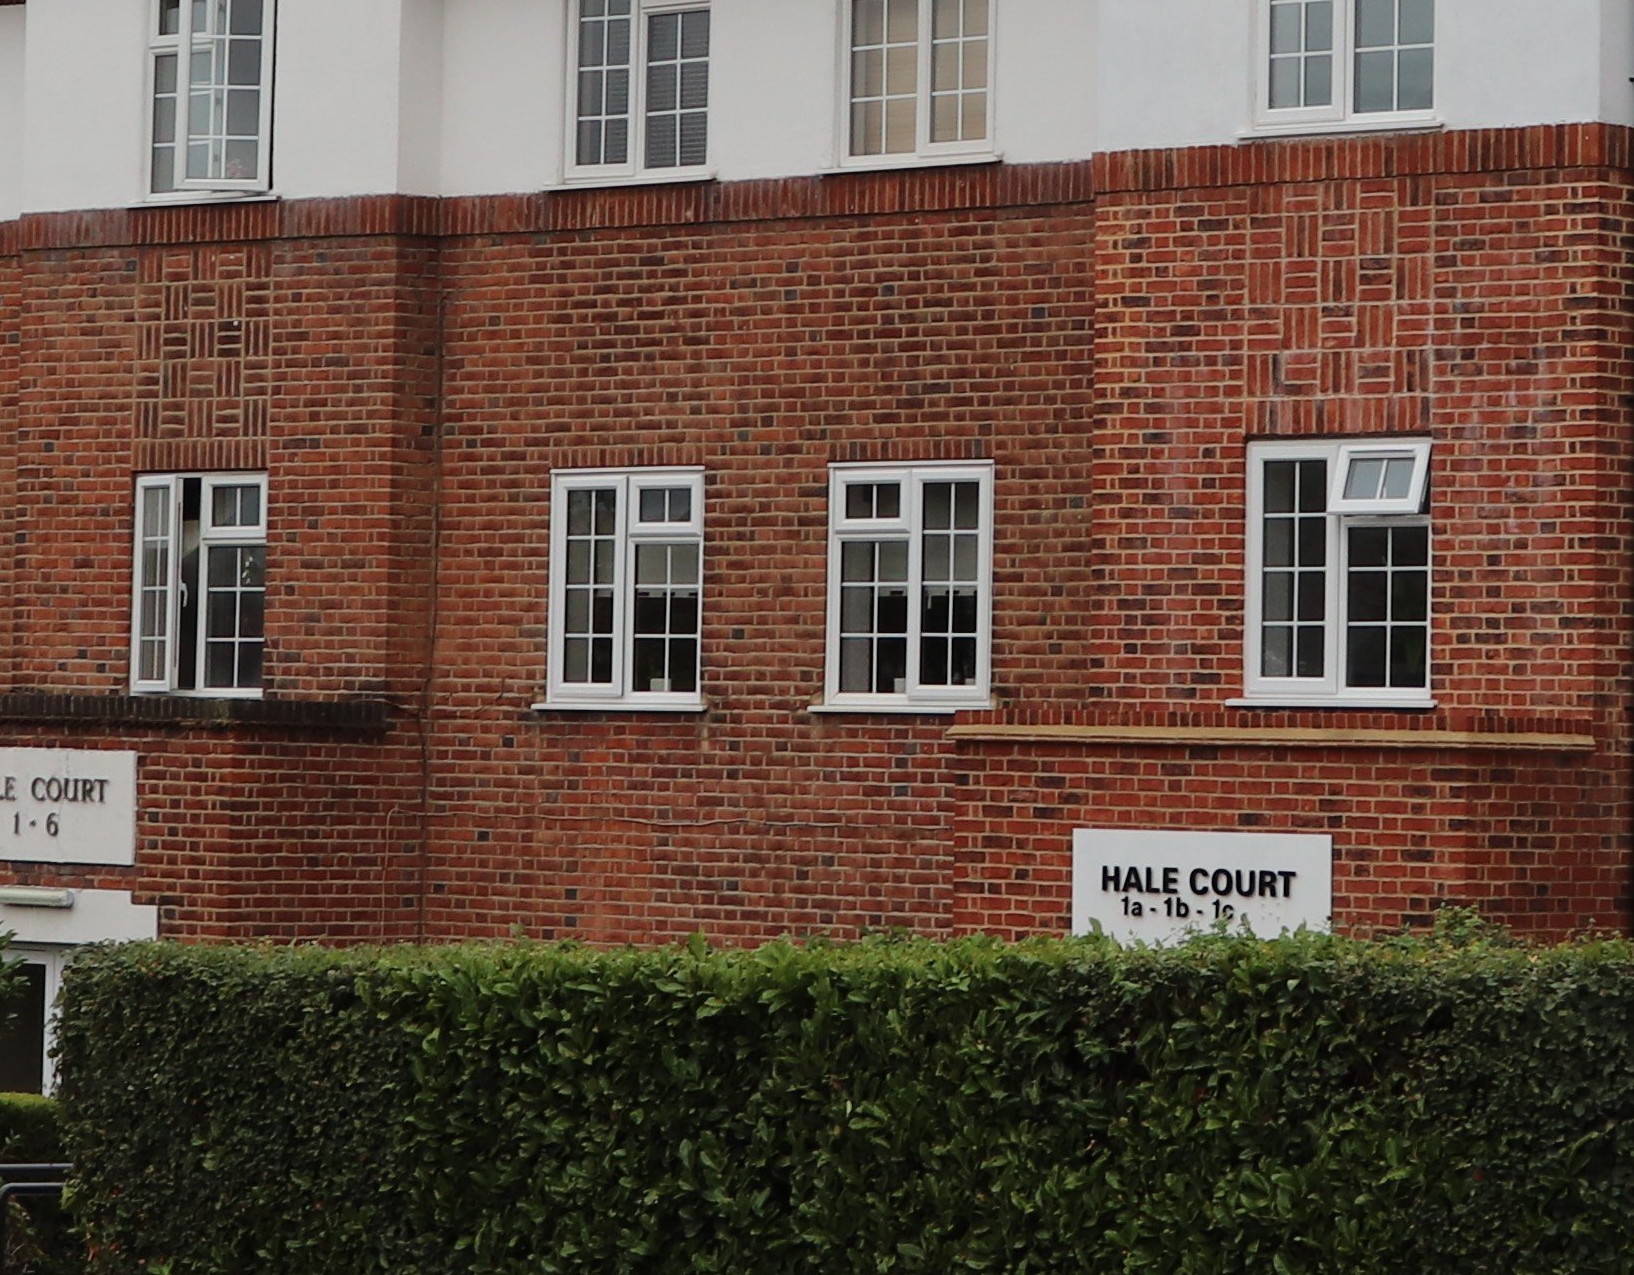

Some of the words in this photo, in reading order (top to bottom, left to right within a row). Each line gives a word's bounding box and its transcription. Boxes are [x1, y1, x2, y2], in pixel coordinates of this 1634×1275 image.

[31, 777, 109, 803] COURT
[46, 813, 59, 837] 6
[1101, 865, 1179, 895] HALE
[1189, 868, 1297, 899] COURT
[1121, 897, 1143, 917] 1a
[1163, 898, 1189, 919] 1b
